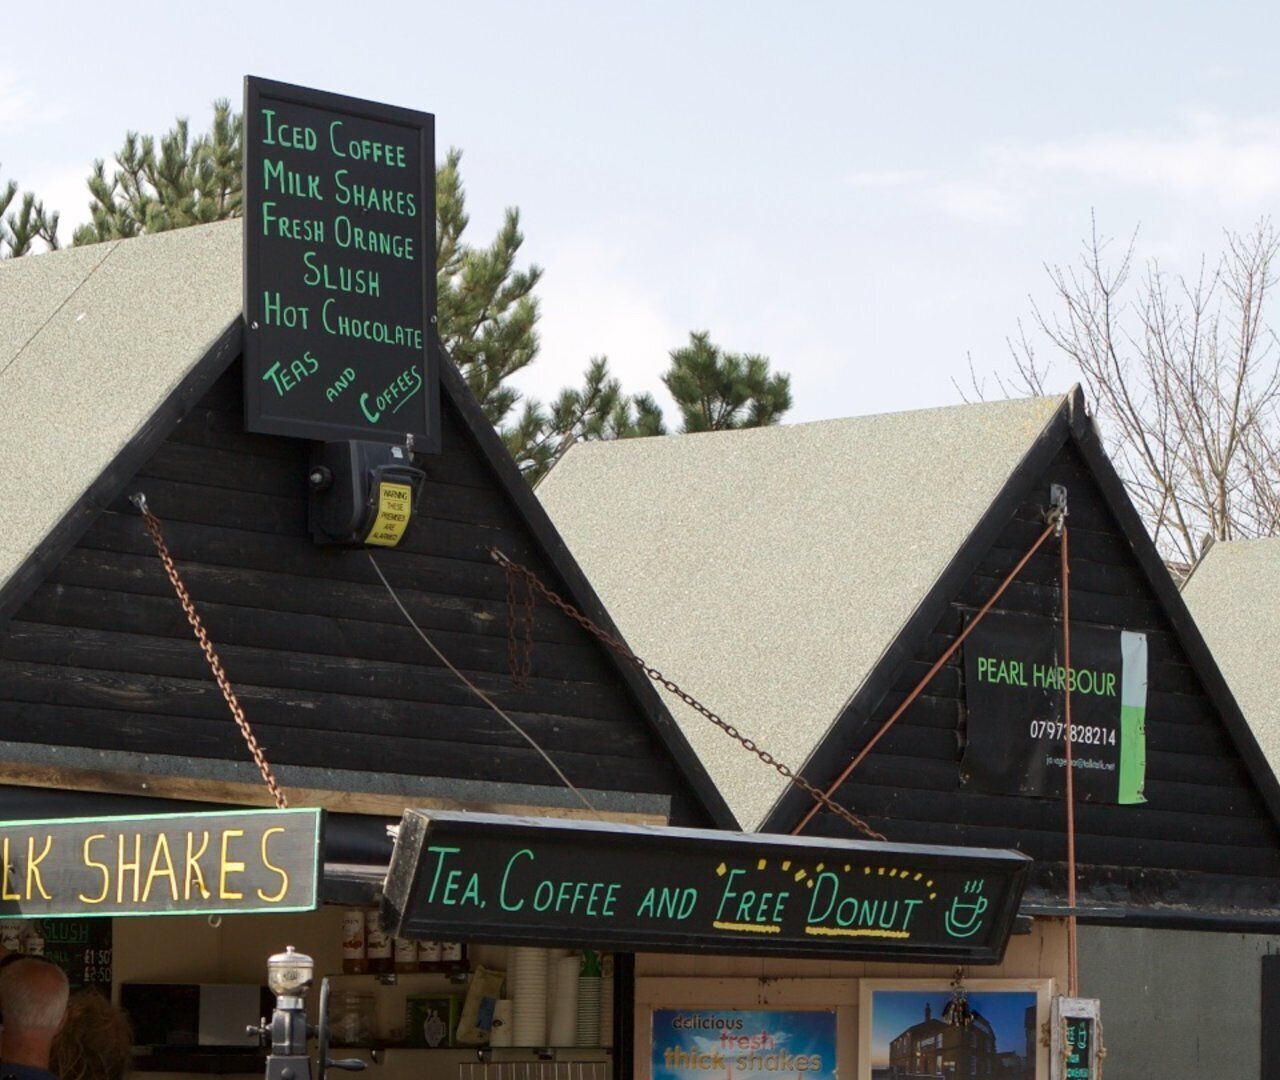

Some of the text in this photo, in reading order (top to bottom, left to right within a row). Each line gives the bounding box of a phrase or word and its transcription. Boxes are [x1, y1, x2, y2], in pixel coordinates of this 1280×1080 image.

[261, 109, 406, 167] ICED COFFEE
[263, 159, 416, 217] MILK SHAKES
[262, 202, 414, 260] FRESH ORANGE
[304, 252, 380, 297] SLUSH
[264, 291, 423, 349] HOT CHOCOLATE
[262, 351, 422, 423] TEAS AND COFFEES
[977, 656, 1117, 697] PEARL HARBOUR
[78, 827, 290, 904] SHAKES
[499, 849, 622, 916] COFFEE
[637, 887, 698, 921] AND
[716, 868, 790, 923] FREE
[808, 872, 923, 931] DONUT
[673, 1015, 744, 1030] delicious
[720, 1030, 776, 1050] fresh
[664, 1045, 823, 1072] thick shakes
